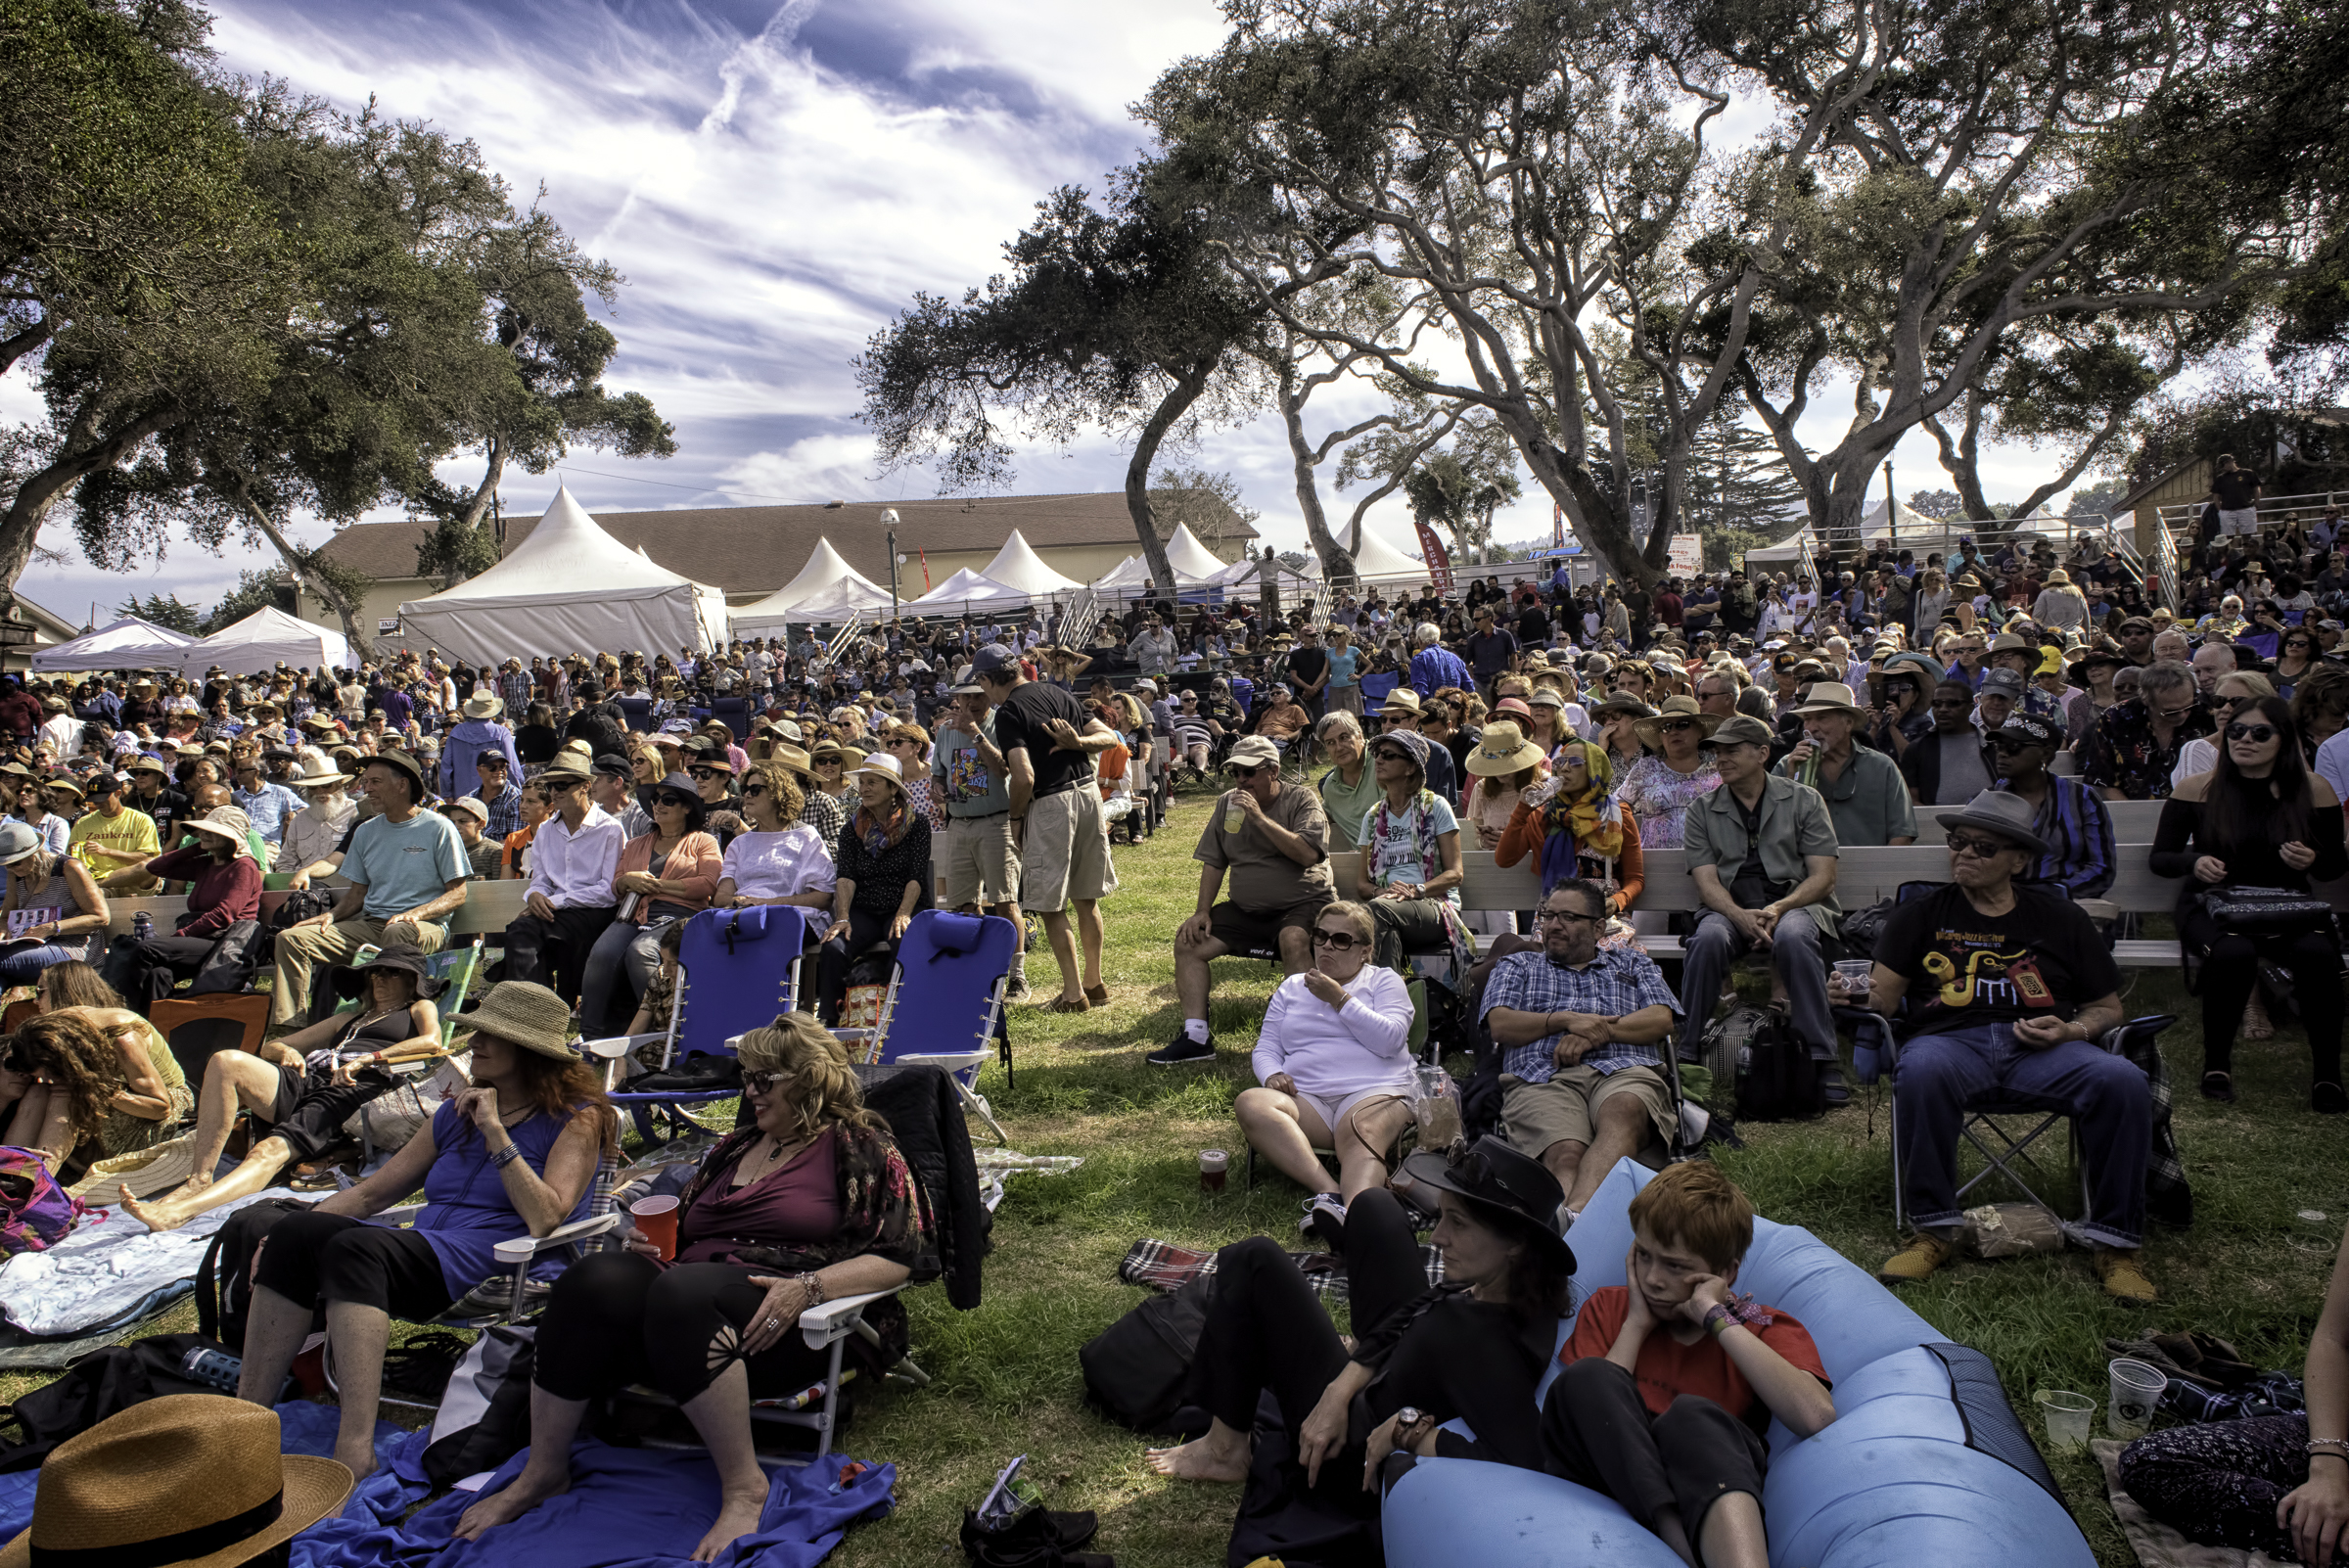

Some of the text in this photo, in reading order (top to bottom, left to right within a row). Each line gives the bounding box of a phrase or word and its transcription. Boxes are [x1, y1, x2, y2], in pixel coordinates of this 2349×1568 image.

[968, 774, 988, 789] JAZZ
[86, 831, 134, 841] Zankou
[1387, 834, 1404, 843] AZZ
